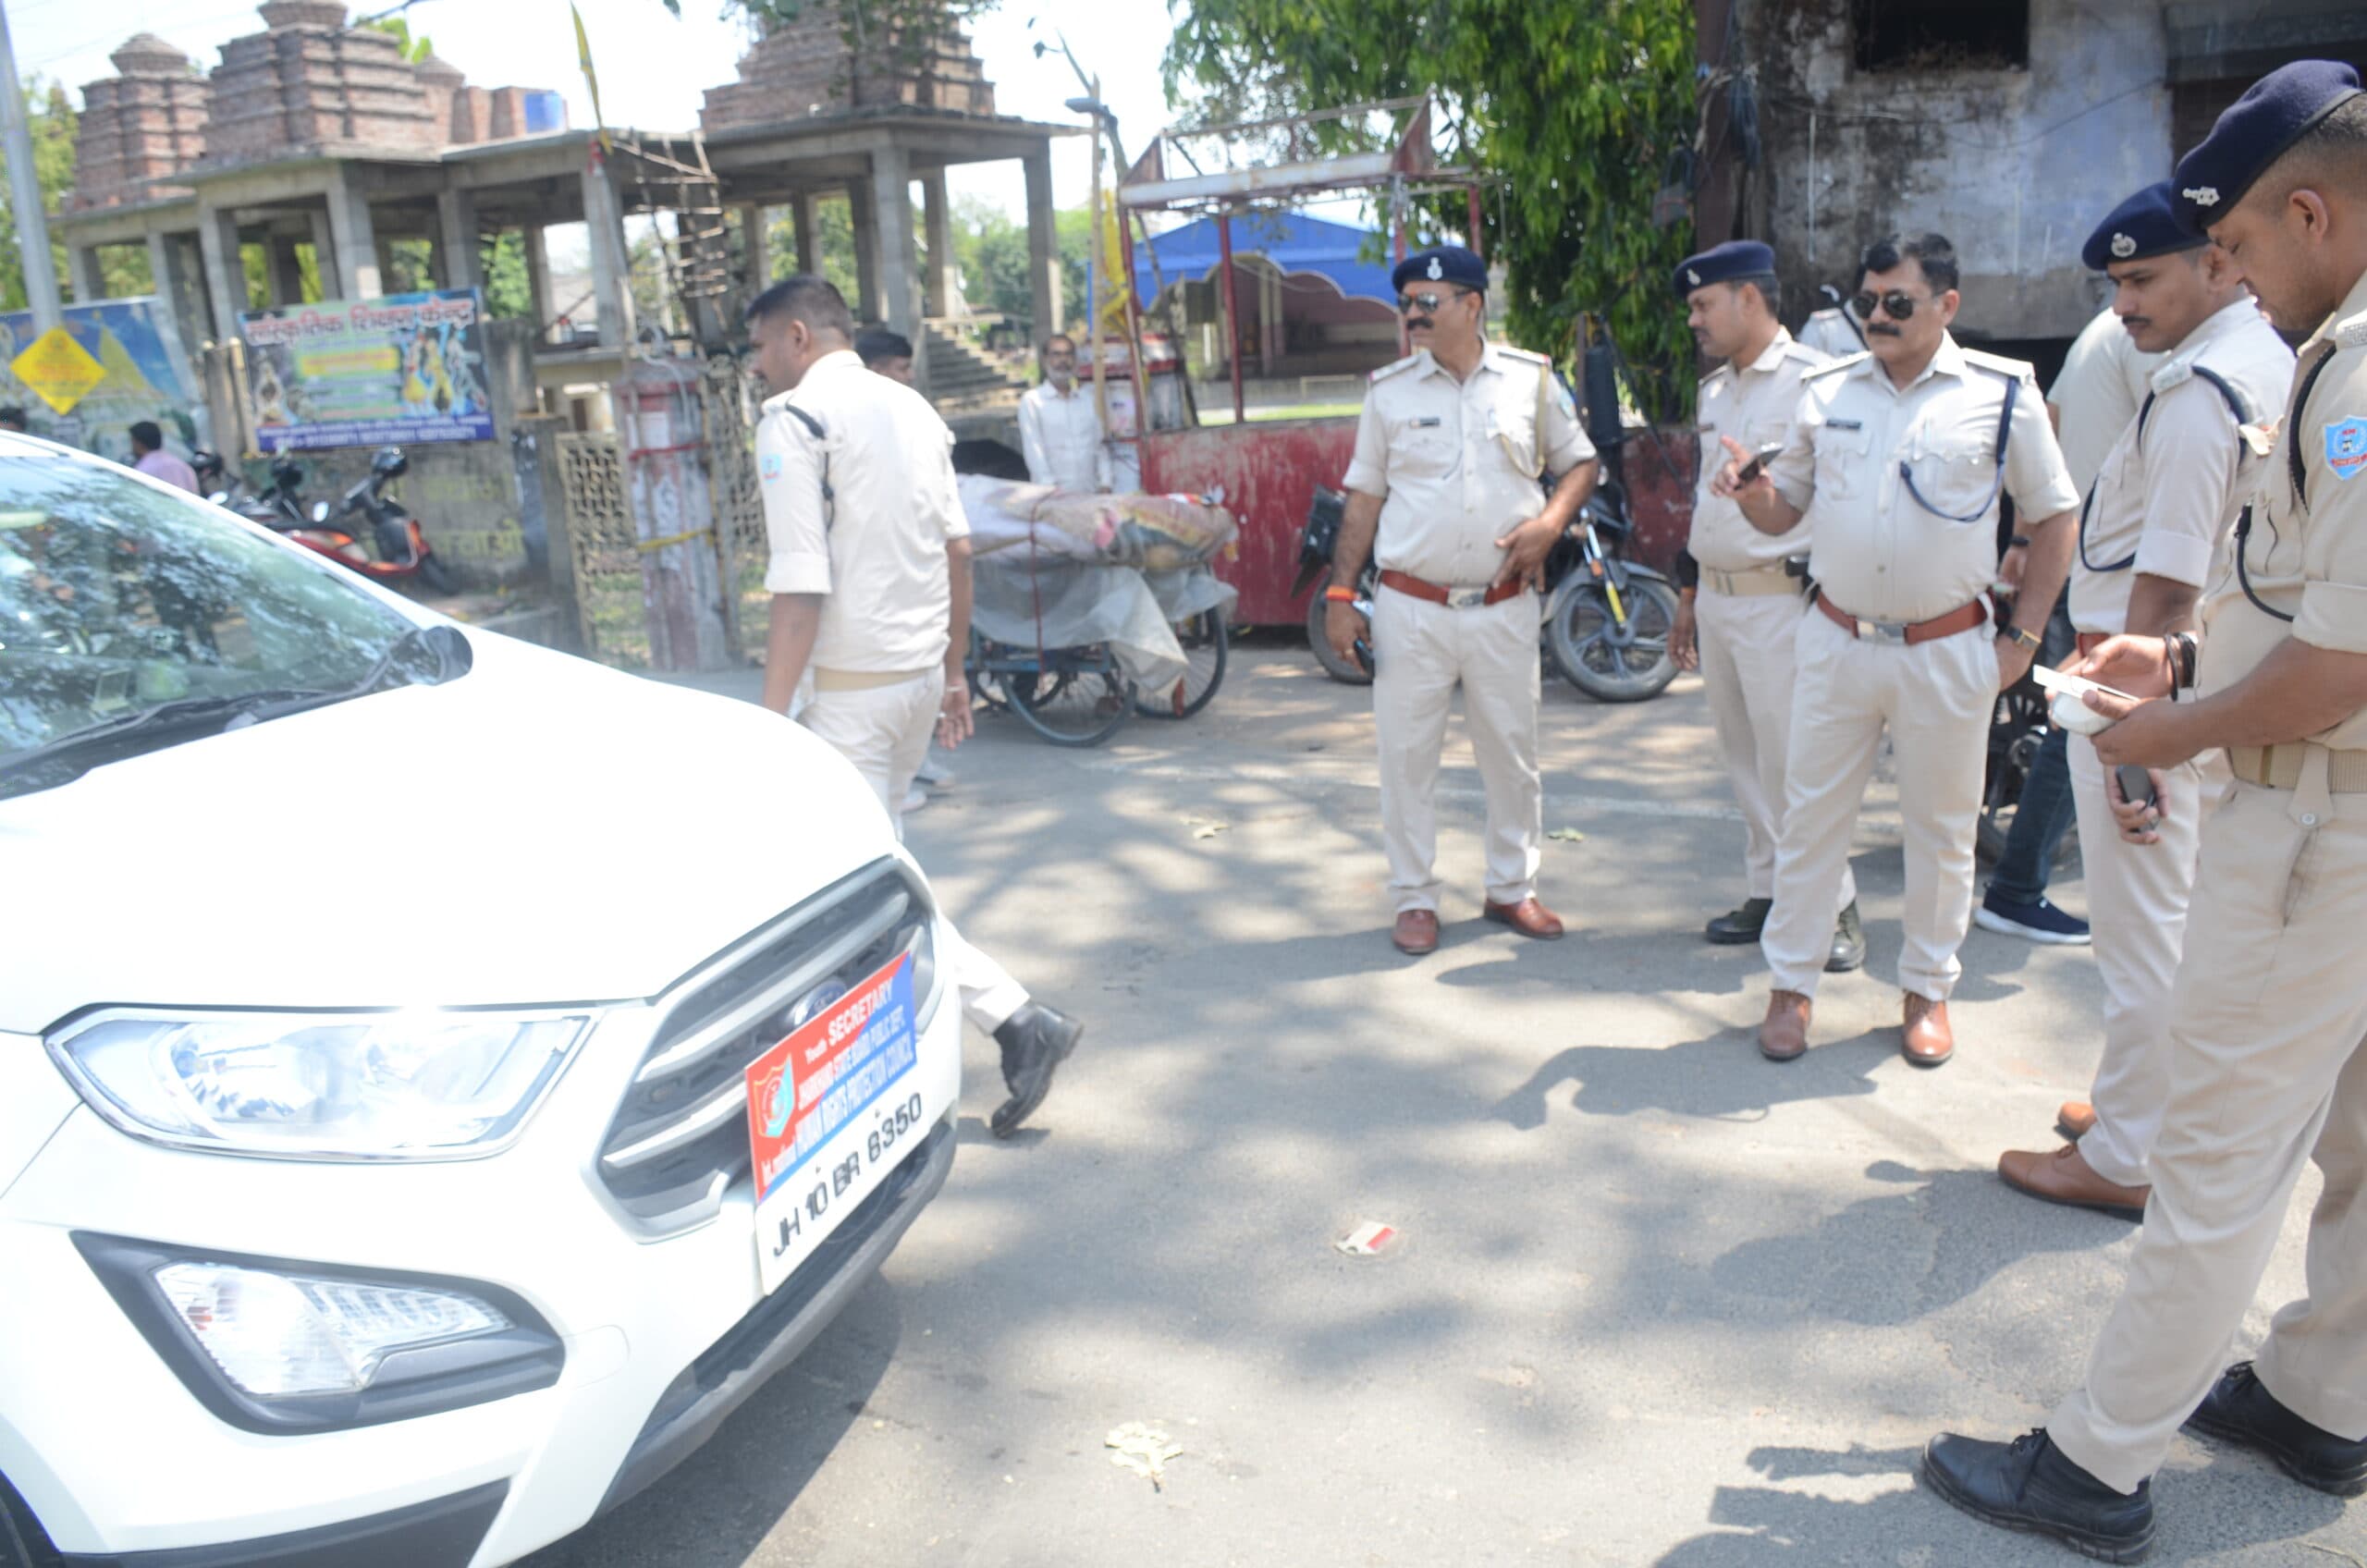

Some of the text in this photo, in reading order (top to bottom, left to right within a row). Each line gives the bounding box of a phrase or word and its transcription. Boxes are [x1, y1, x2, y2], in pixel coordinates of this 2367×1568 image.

[828, 978, 894, 1046] SECRETARY
[773, 1207, 801, 1257] JH
[806, 1181, 828, 1221] 10
[832, 1151, 861, 1198] BR
